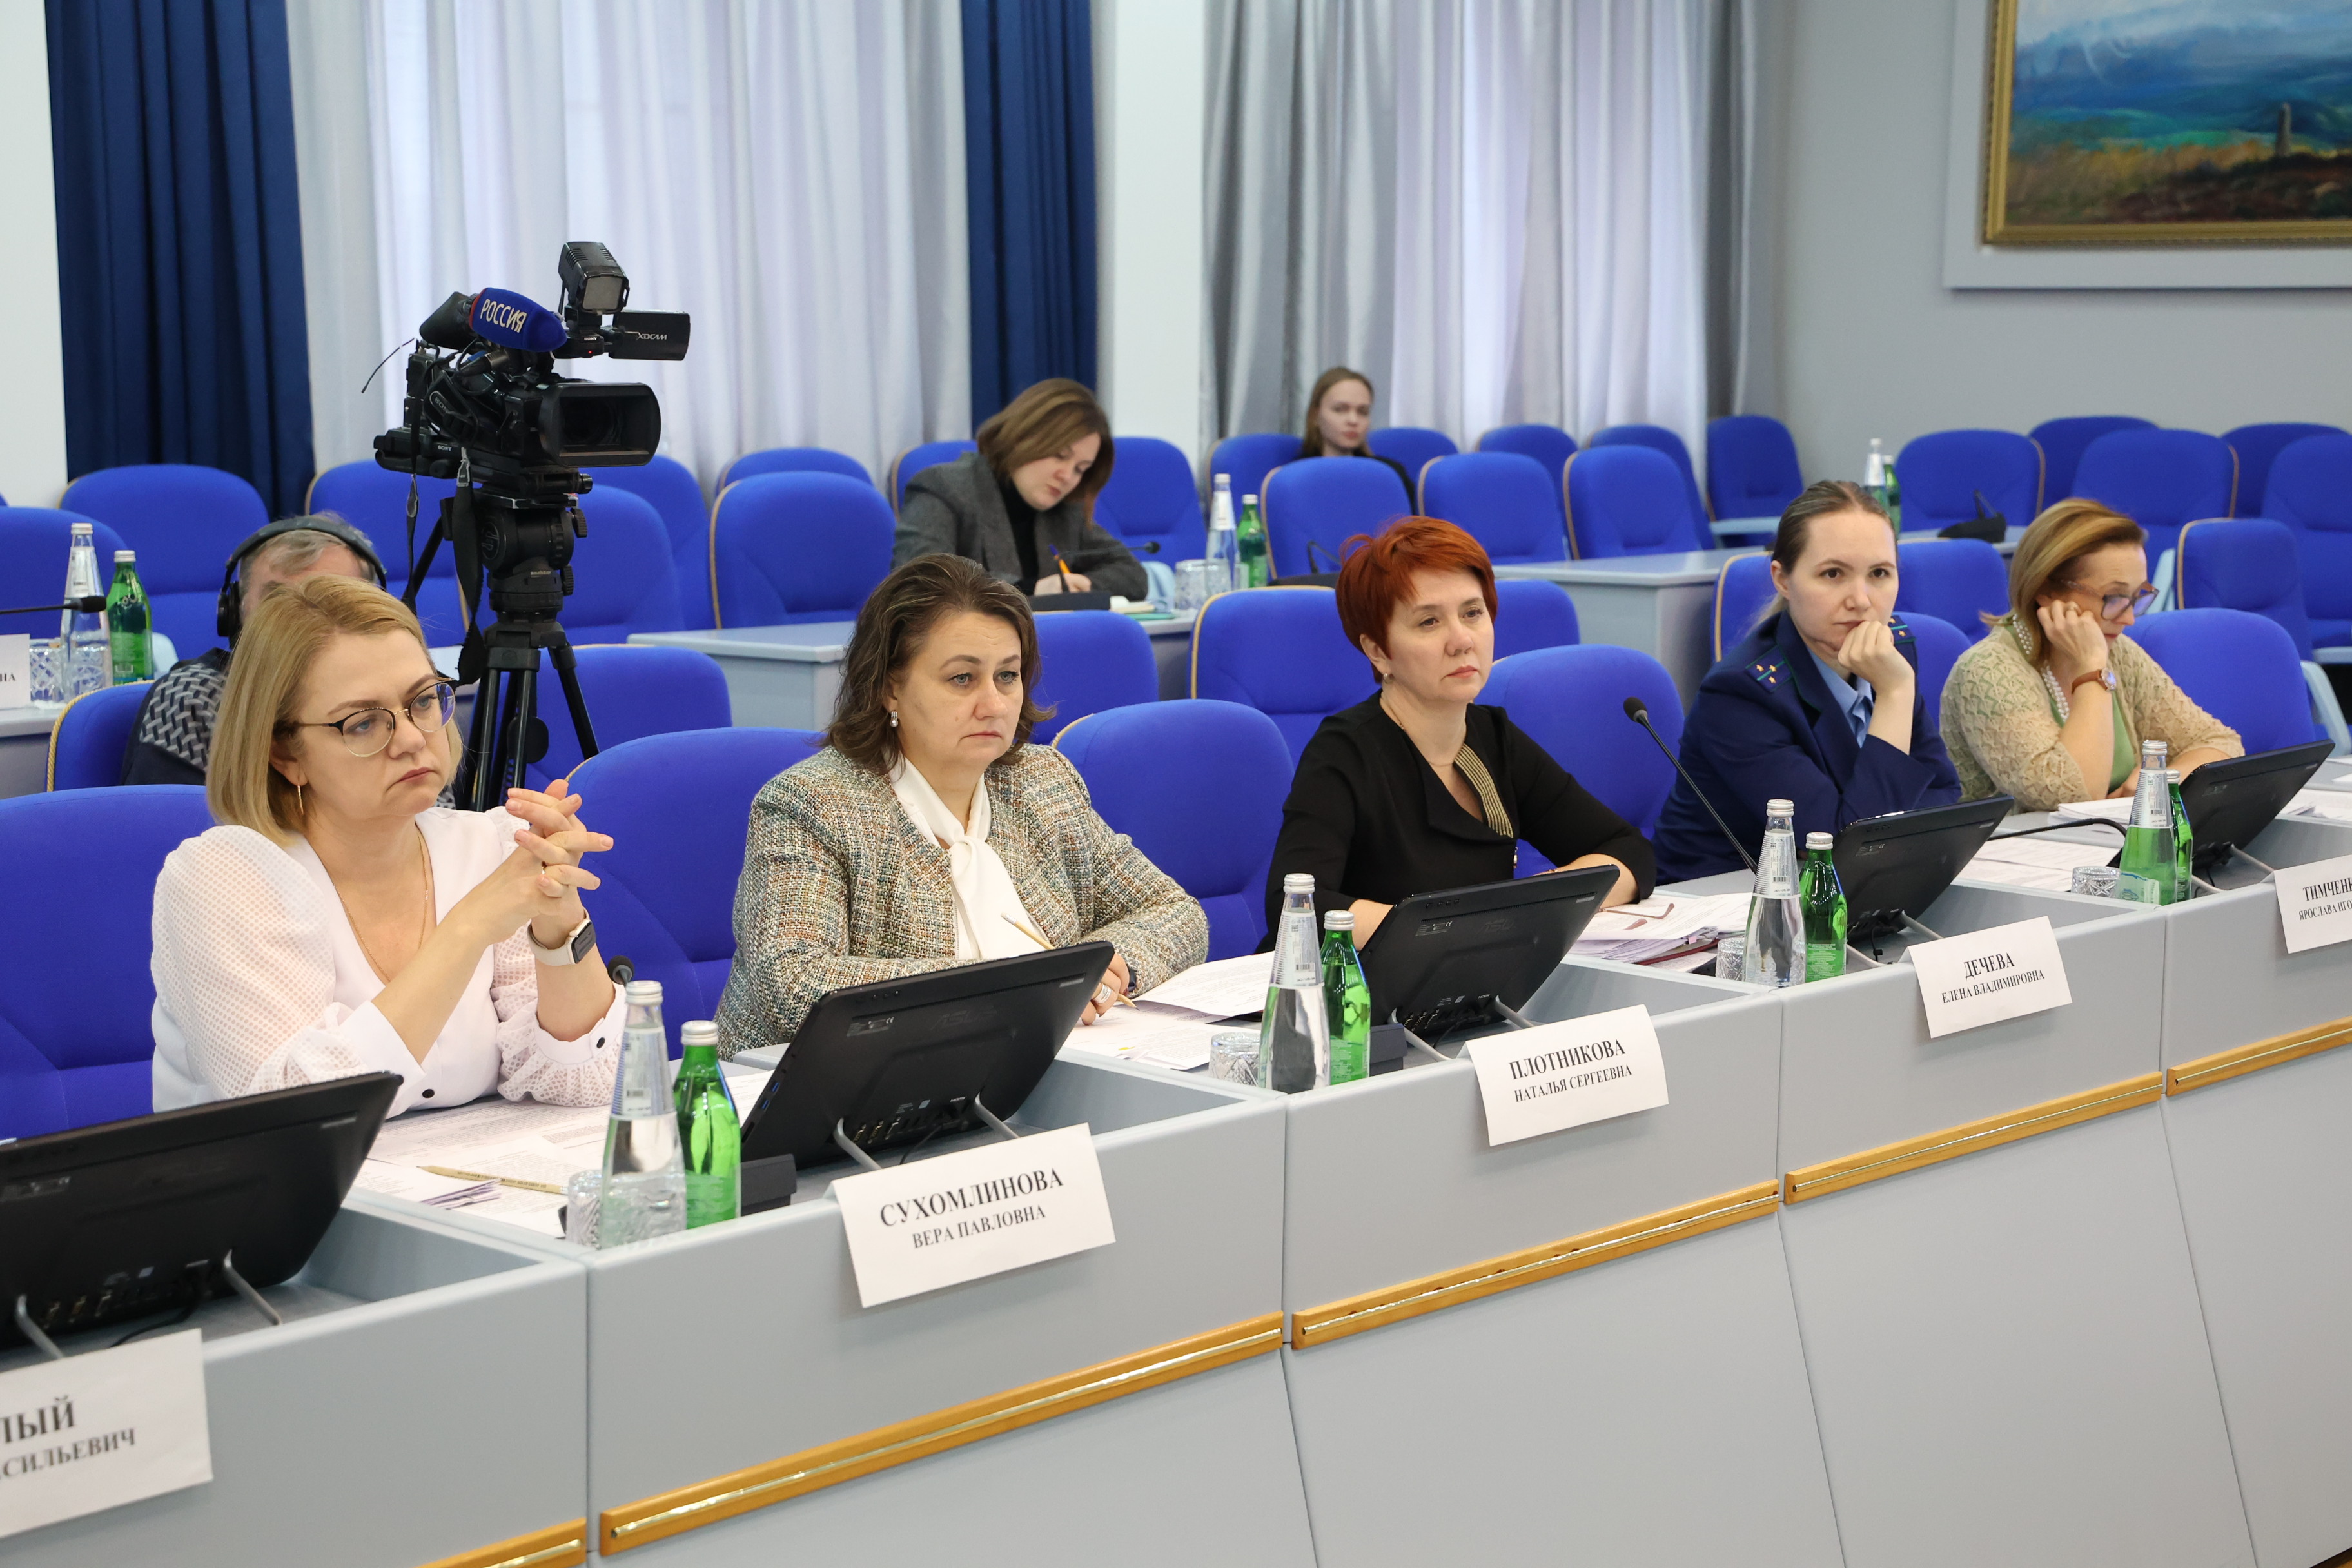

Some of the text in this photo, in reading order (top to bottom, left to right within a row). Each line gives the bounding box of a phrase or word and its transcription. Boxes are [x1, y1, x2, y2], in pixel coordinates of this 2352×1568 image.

[480, 299, 527, 333] РОССИЯ
[2298, 904, 2337, 921] ЯРОСЛАВА
[1963, 952, 2015, 981] ДЕЧЕВА
[1941, 969, 2045, 1004] ЕЛЕНА ВЛАДИМИРОВНА
[1509, 1039, 1627, 1080] ПЛОТНИКОВА
[1514, 1064, 1632, 1102] НАТАЛЬЯ СЕРГЕЕВНА
[880, 1168, 1064, 1226] СУХОМЛИНОВА
[912, 1204, 1046, 1248] ВЕРА ПАВЛОВНА
[0, 1427, 135, 1480] СИЛЬЕВИЧ
